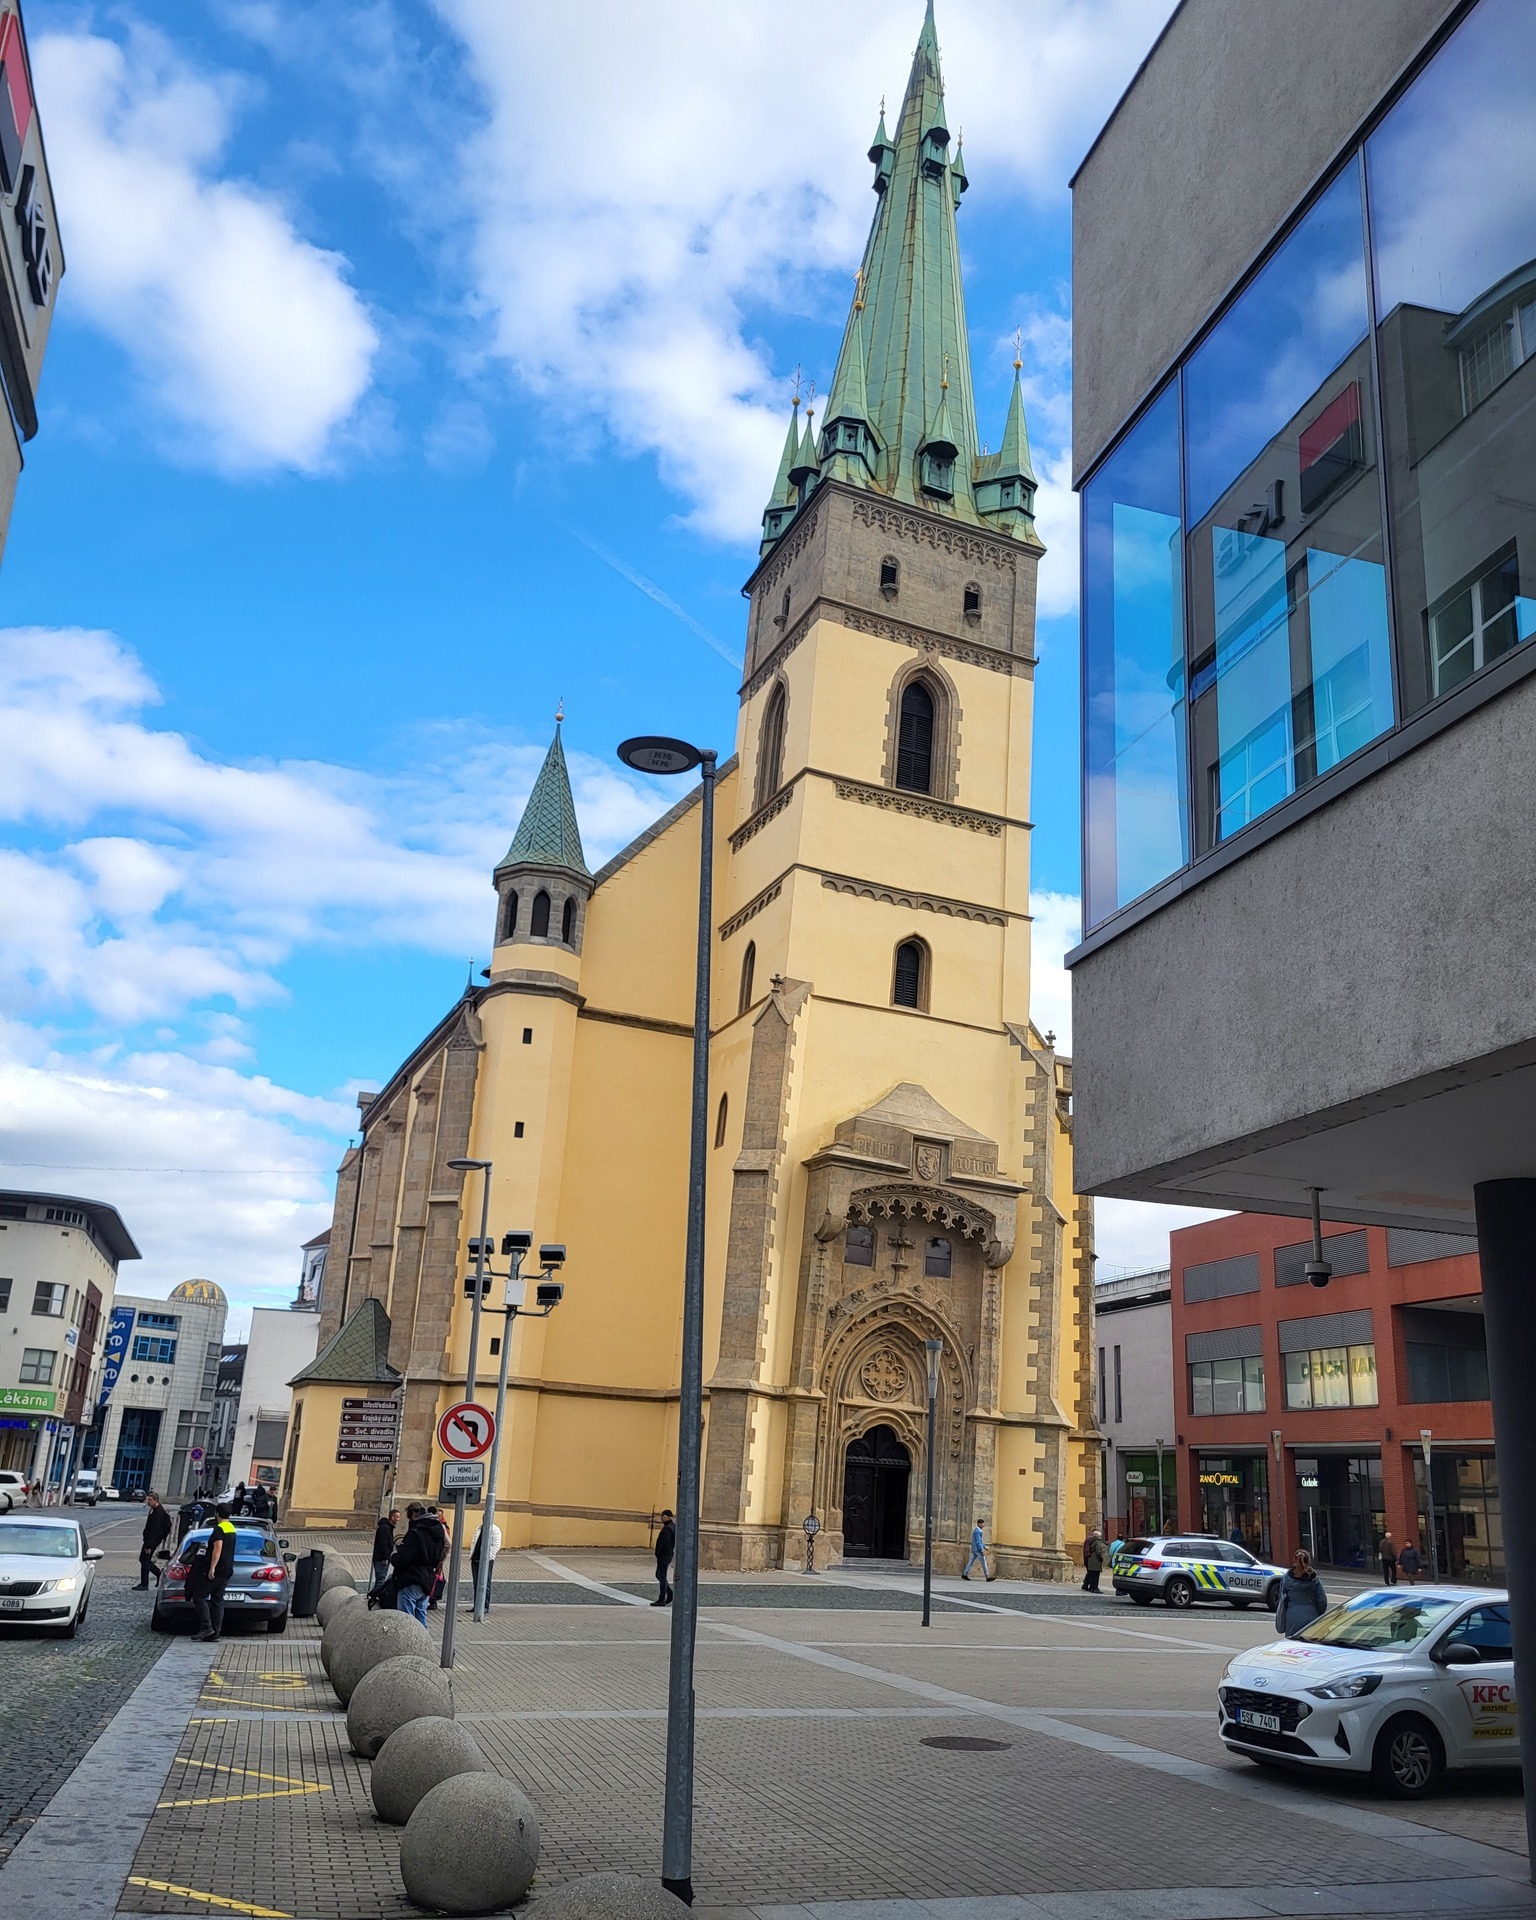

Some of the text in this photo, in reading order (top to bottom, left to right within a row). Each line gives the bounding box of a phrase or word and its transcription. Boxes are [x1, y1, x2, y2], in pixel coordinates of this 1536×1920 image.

[0, 1392, 47, 1406] ékárna
[352, 1440, 393, 1450] Dům kultury
[361, 1454, 390, 1462] Muzeum
[457, 1466, 472, 1474] MIMO
[448, 1474, 480, 1483] ZÁSOBOVÁNÍ
[1228, 1576, 1262, 1588] POLICIE
[2, 1600, 20, 1608] 4089
[1472, 1685, 1510, 1703] KFC
[1241, 1711, 1254, 1725] 5SK
[1259, 1714, 1277, 1730] 7401
[1473, 1728, 1513, 1736] WWW.KFC.CZ
